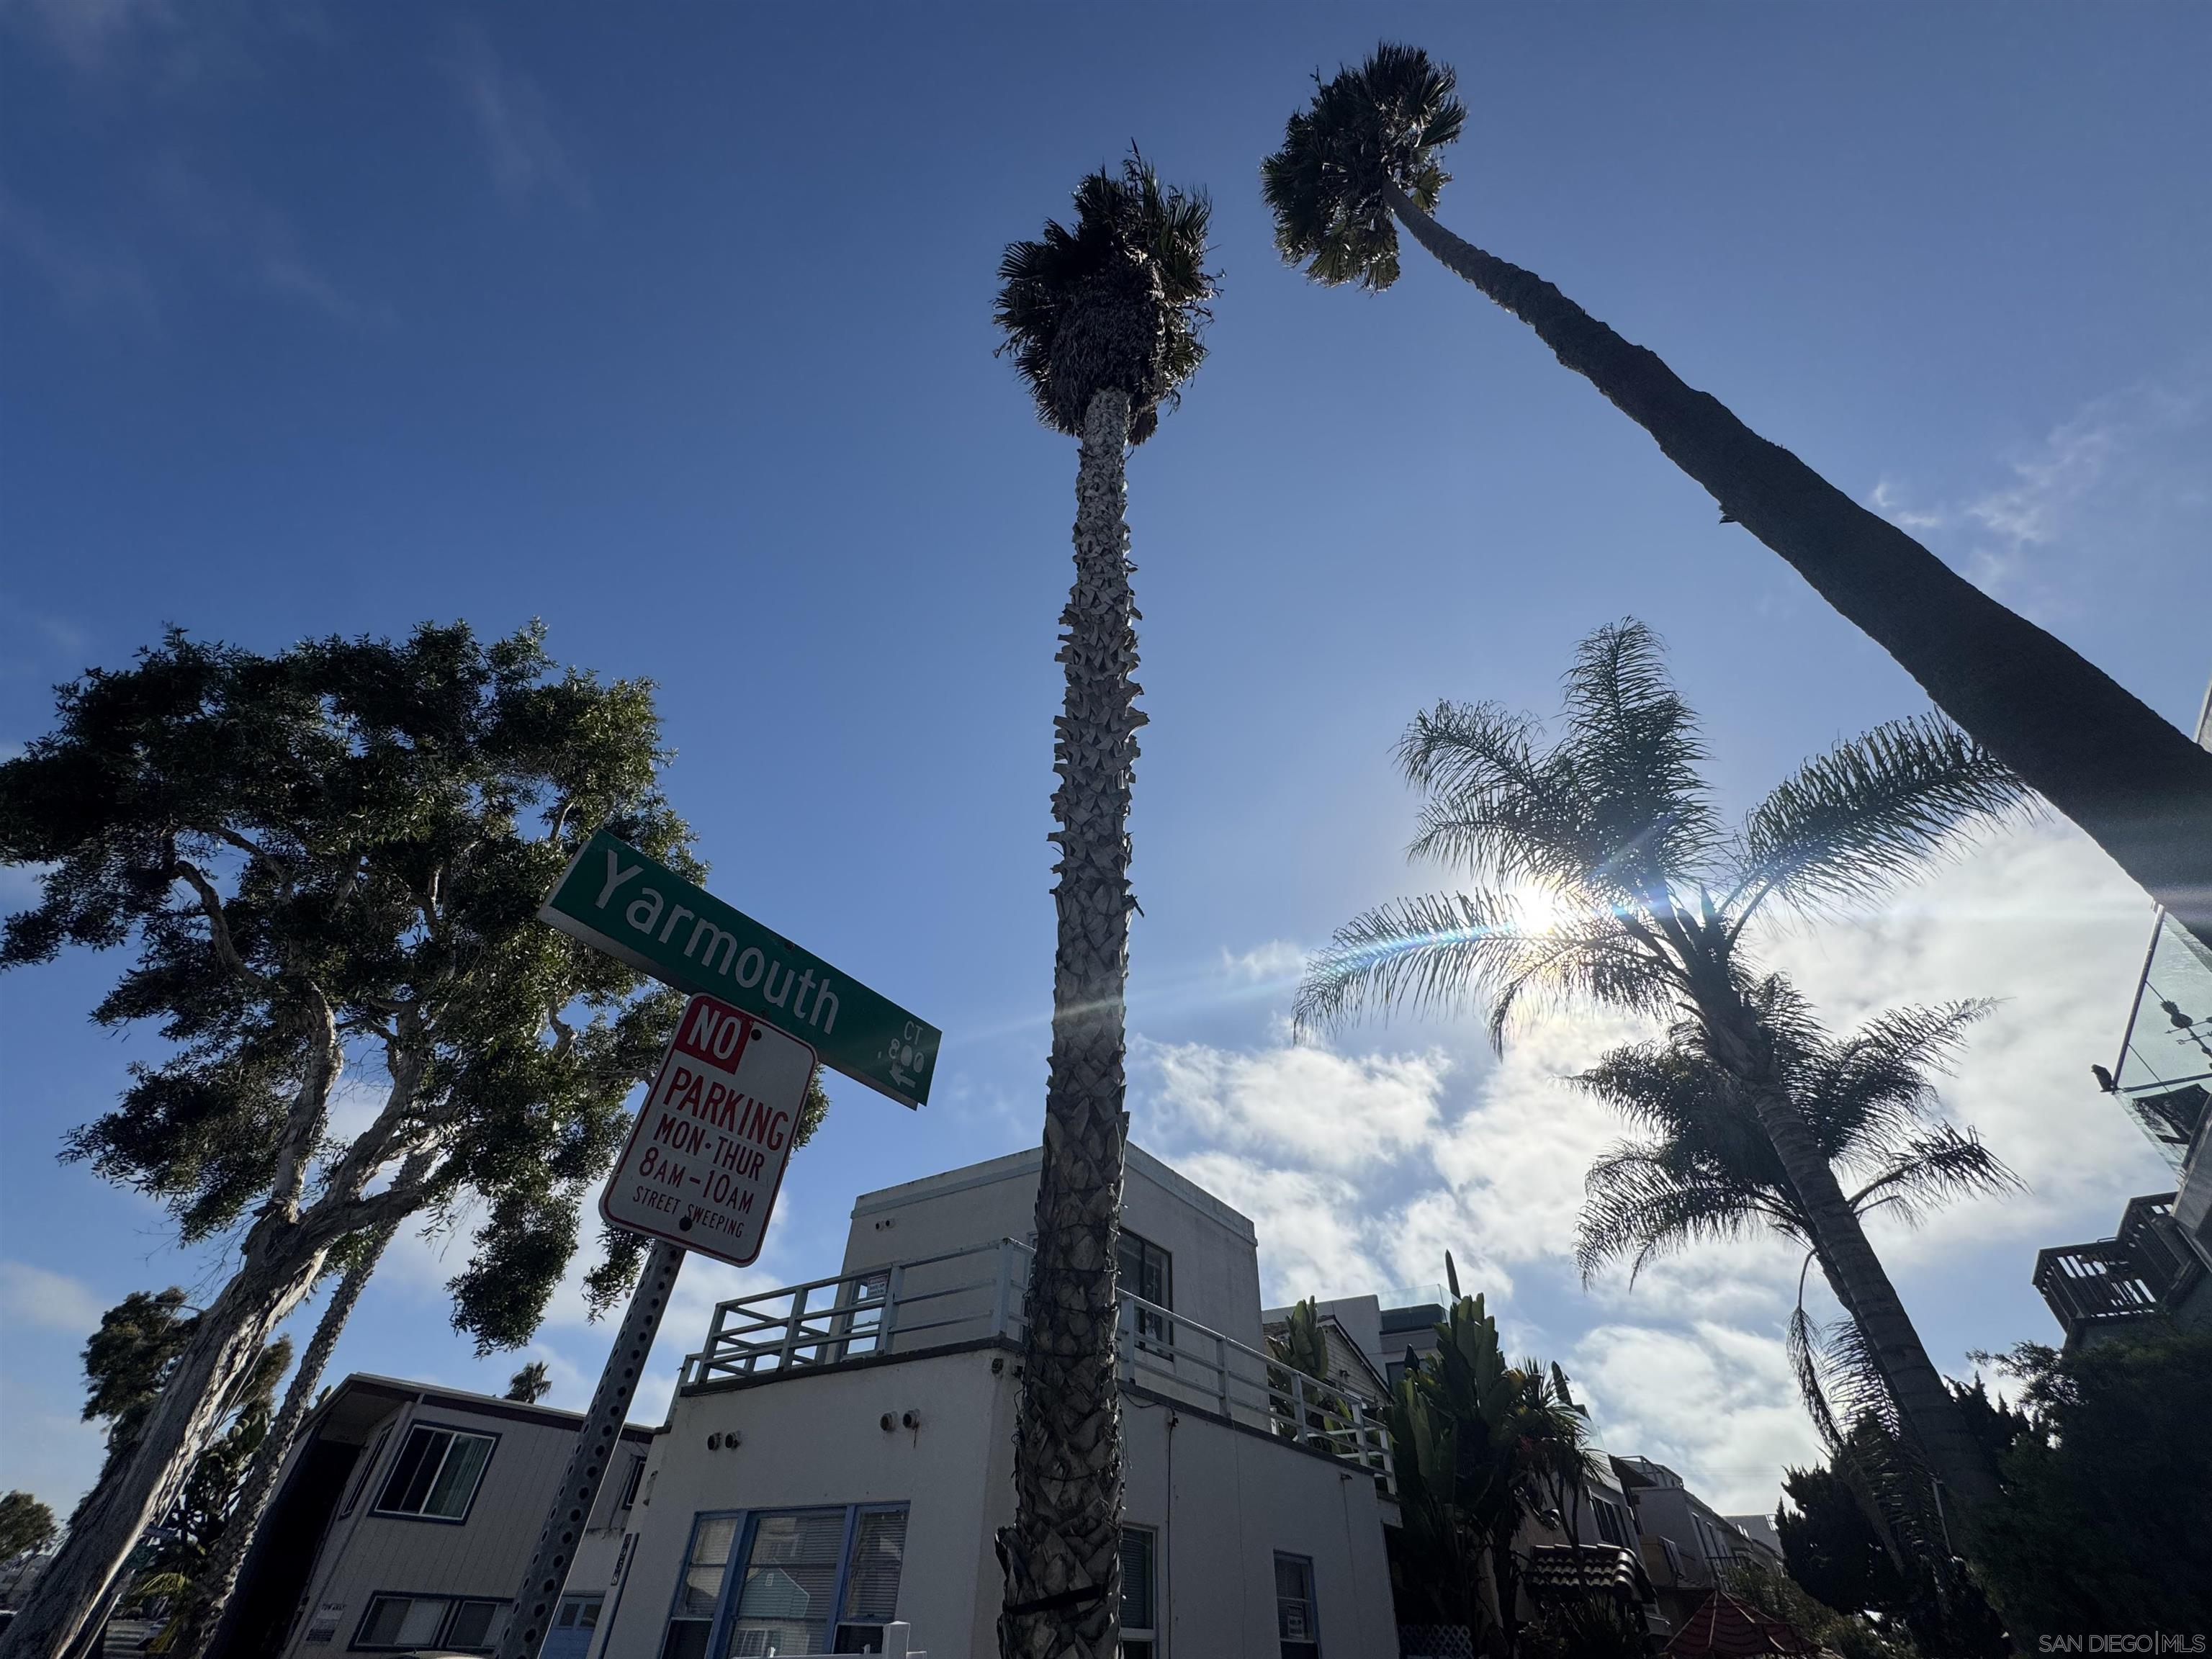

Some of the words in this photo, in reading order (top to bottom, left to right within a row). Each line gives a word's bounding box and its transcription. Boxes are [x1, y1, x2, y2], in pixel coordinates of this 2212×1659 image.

[594, 849, 839, 1035] Yarmouth
[686, 1004, 741, 1060] NO
[904, 1020, 923, 1045] CT
[663, 1066, 788, 1151] PARKING
[633, 1186, 681, 1215] STREET
[685, 1204, 745, 1238] SWEEPING
